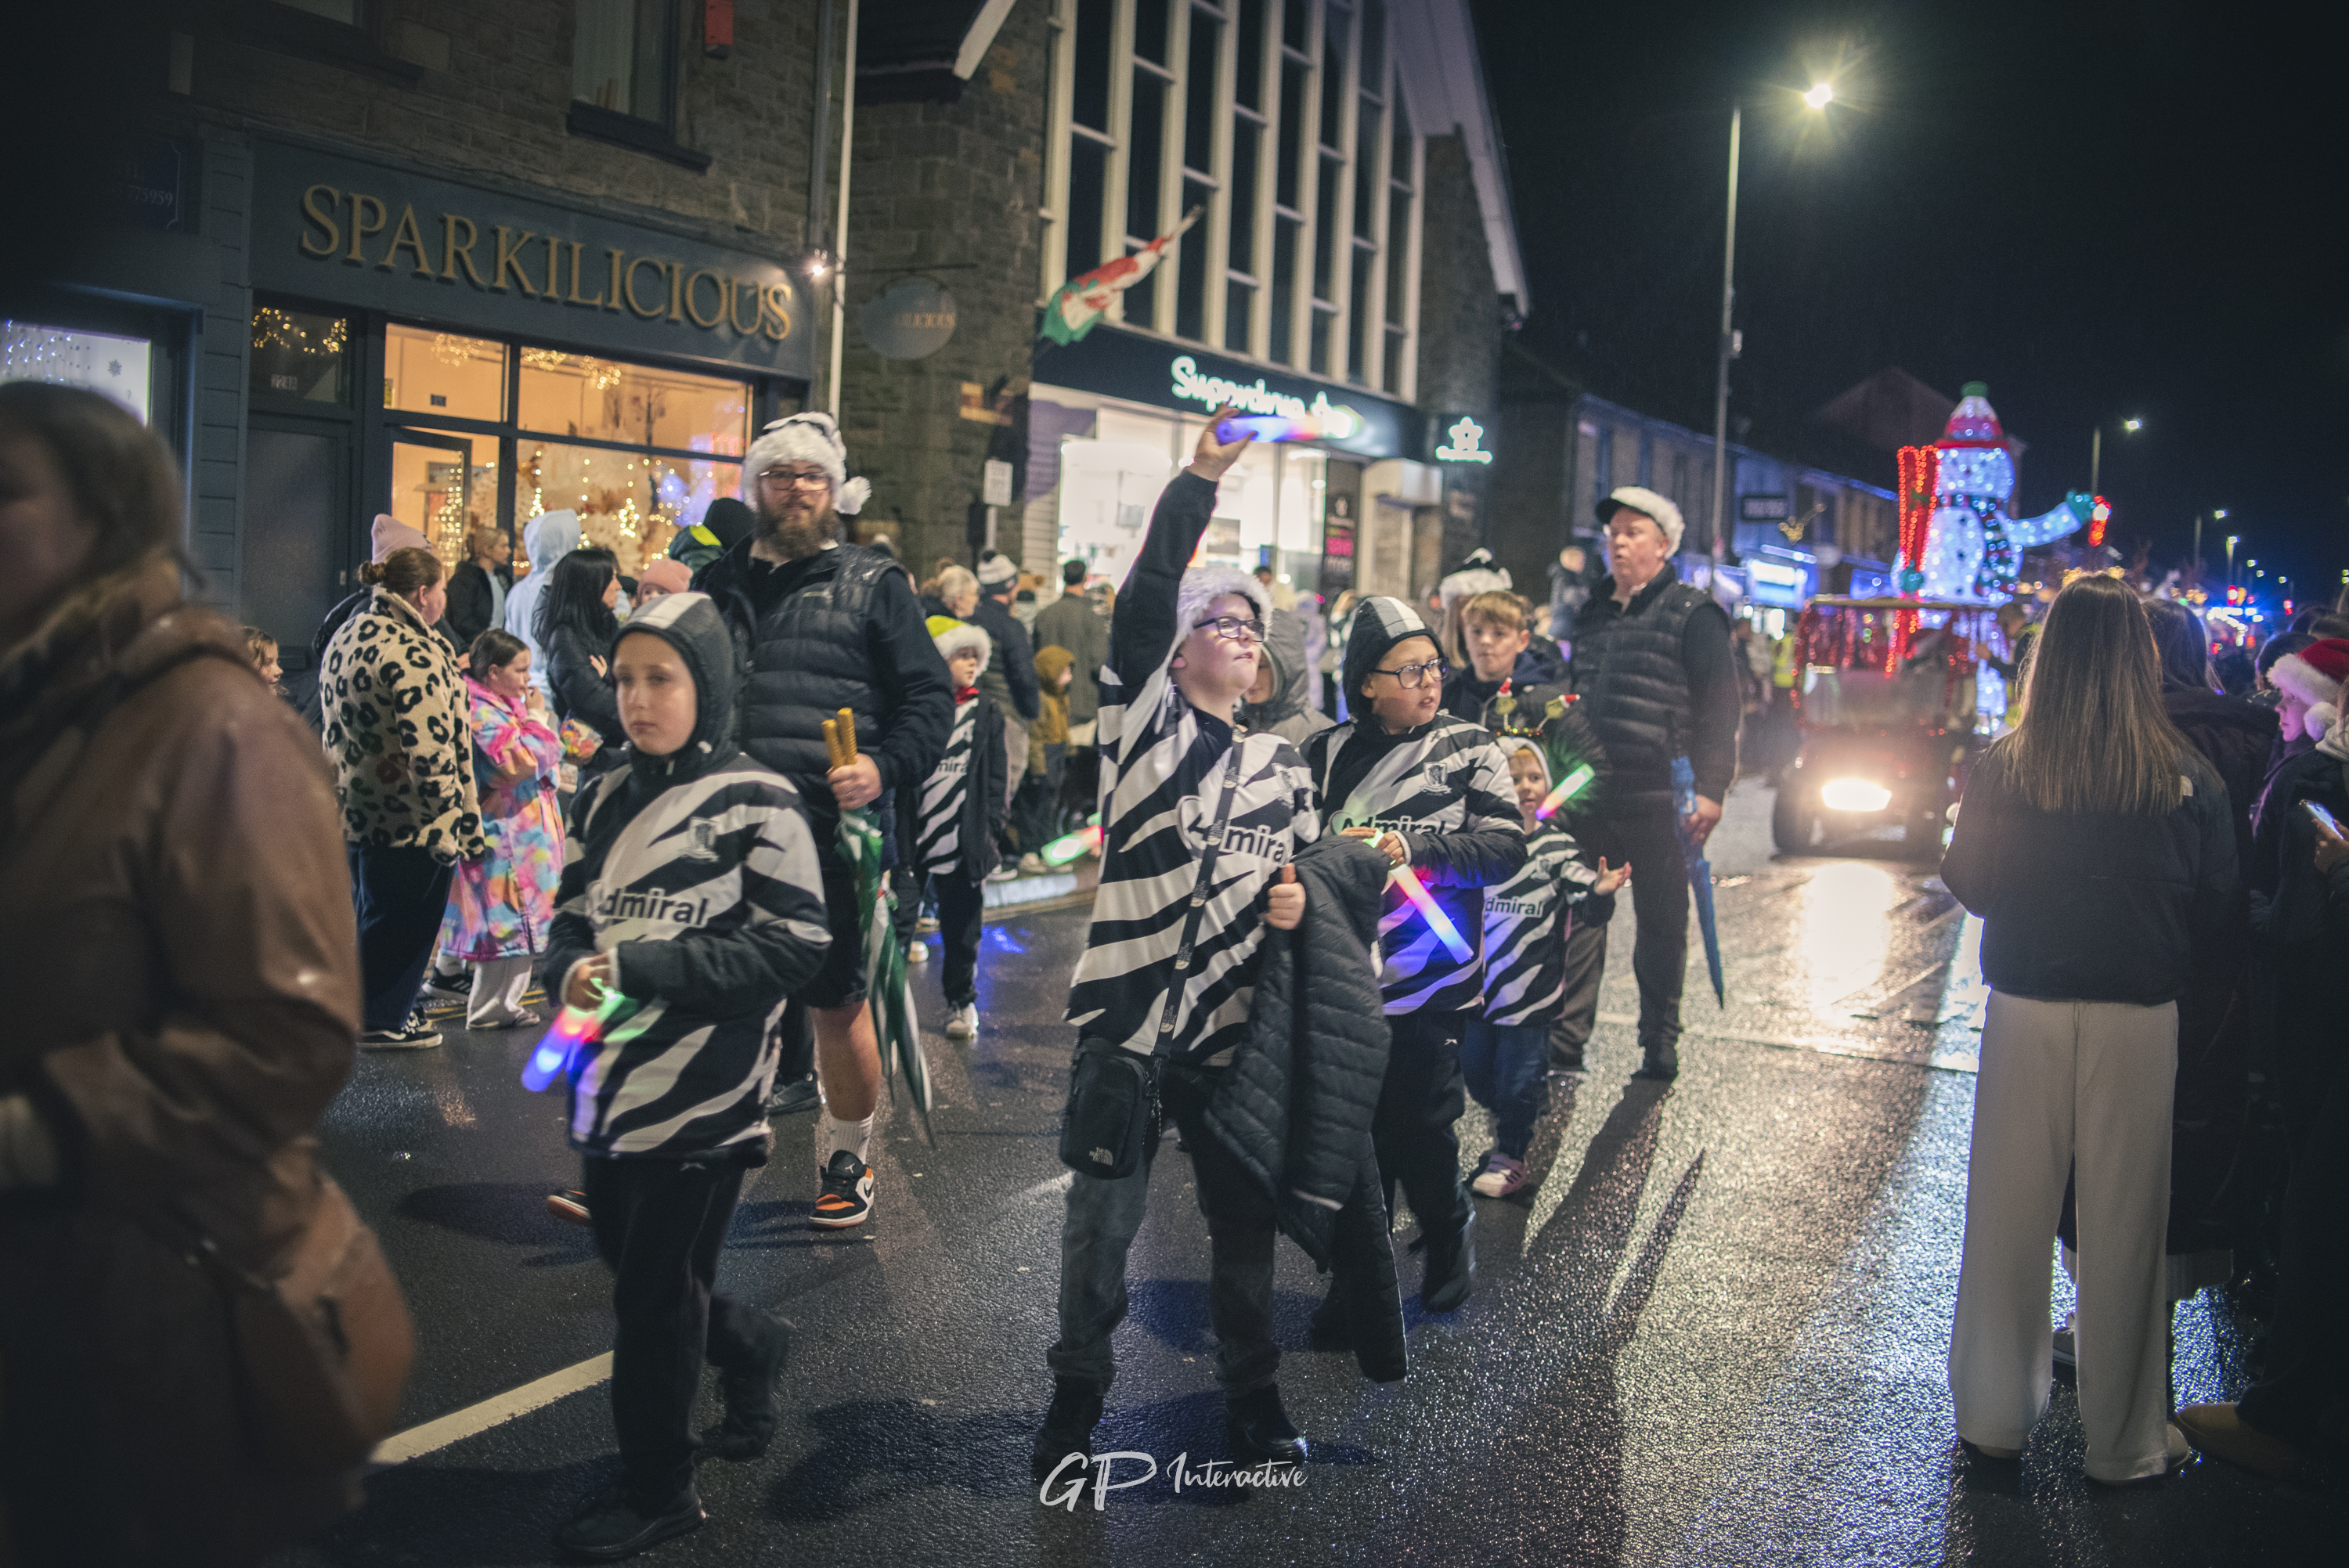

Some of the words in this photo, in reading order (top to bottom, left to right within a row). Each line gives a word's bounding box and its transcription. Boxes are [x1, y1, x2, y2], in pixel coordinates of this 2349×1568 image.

[303, 183, 792, 341] SPARKILICIOUS
[597, 888, 710, 927] dmiral
[1485, 896, 1543, 916] dmiral
